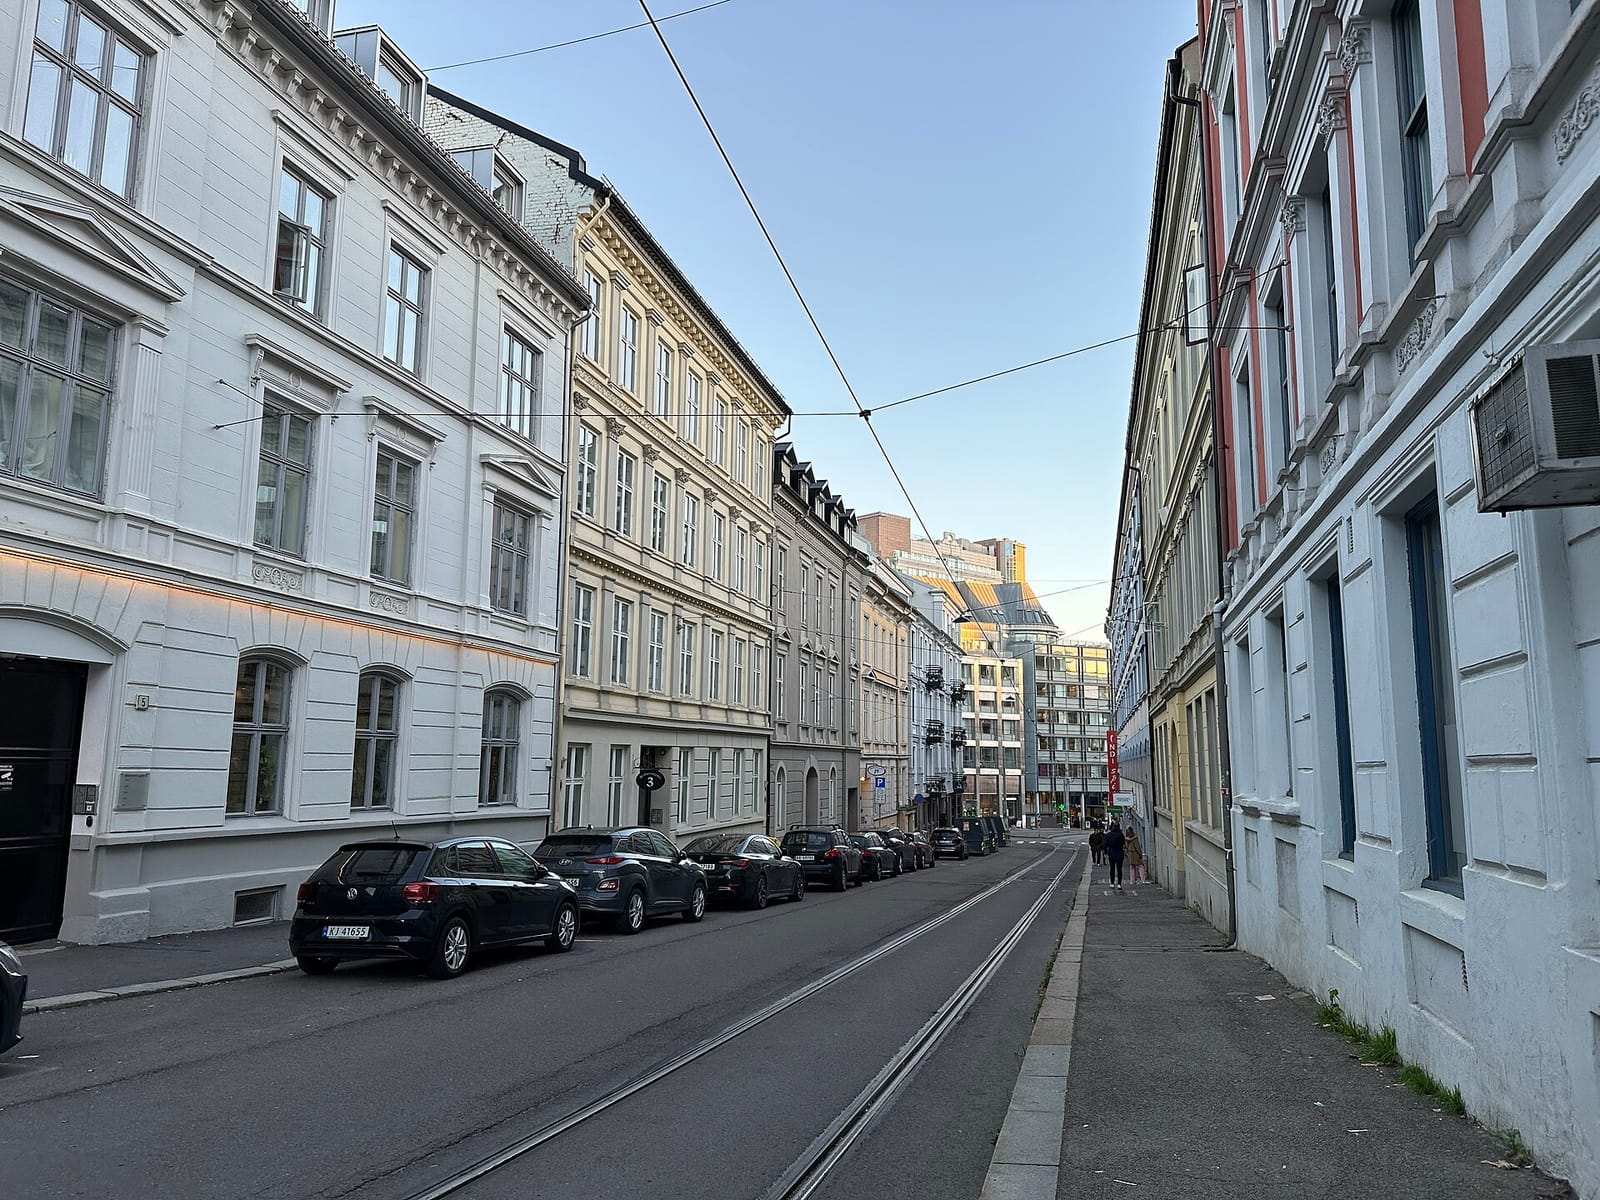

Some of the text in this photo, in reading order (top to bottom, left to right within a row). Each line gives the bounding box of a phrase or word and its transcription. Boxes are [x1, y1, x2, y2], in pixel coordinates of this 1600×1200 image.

[141, 697, 146, 707] 5
[646, 776, 654, 788] 3
[877, 778, 883, 787] P
[341, 927, 367, 936] 41655
